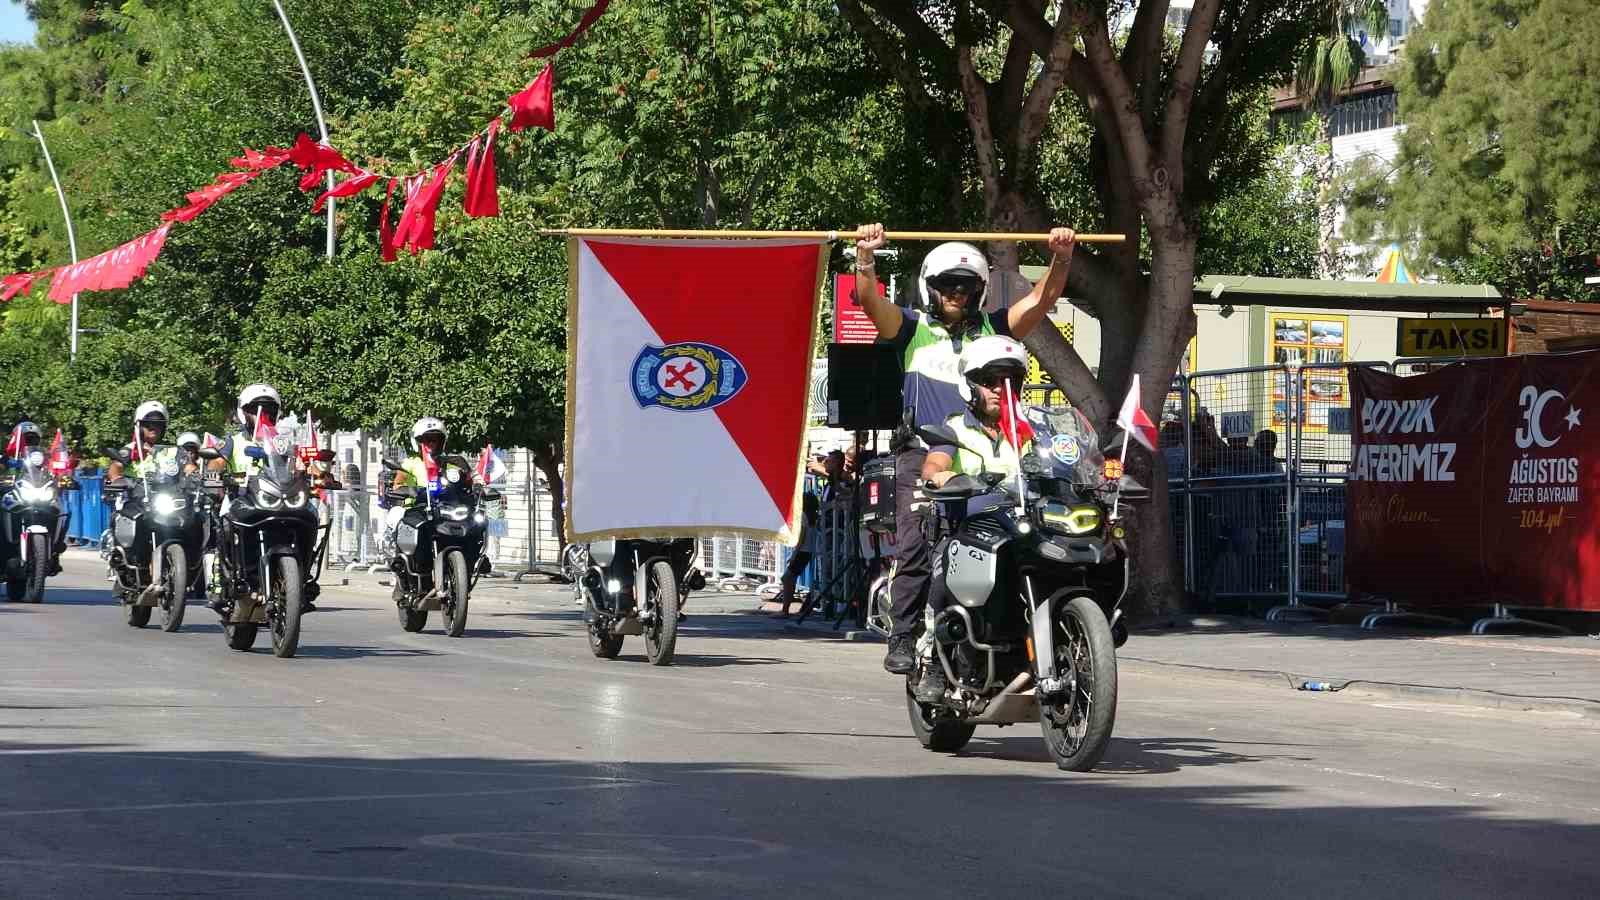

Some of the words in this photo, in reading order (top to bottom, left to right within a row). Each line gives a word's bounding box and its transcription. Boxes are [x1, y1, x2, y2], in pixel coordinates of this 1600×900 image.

[1409, 321, 1498, 349] TAKSİ
[1509, 453, 1579, 484] AĞUSTOS
[1508, 487, 1534, 503] ZAFER
[1537, 486, 1578, 503] BAYRAMI
